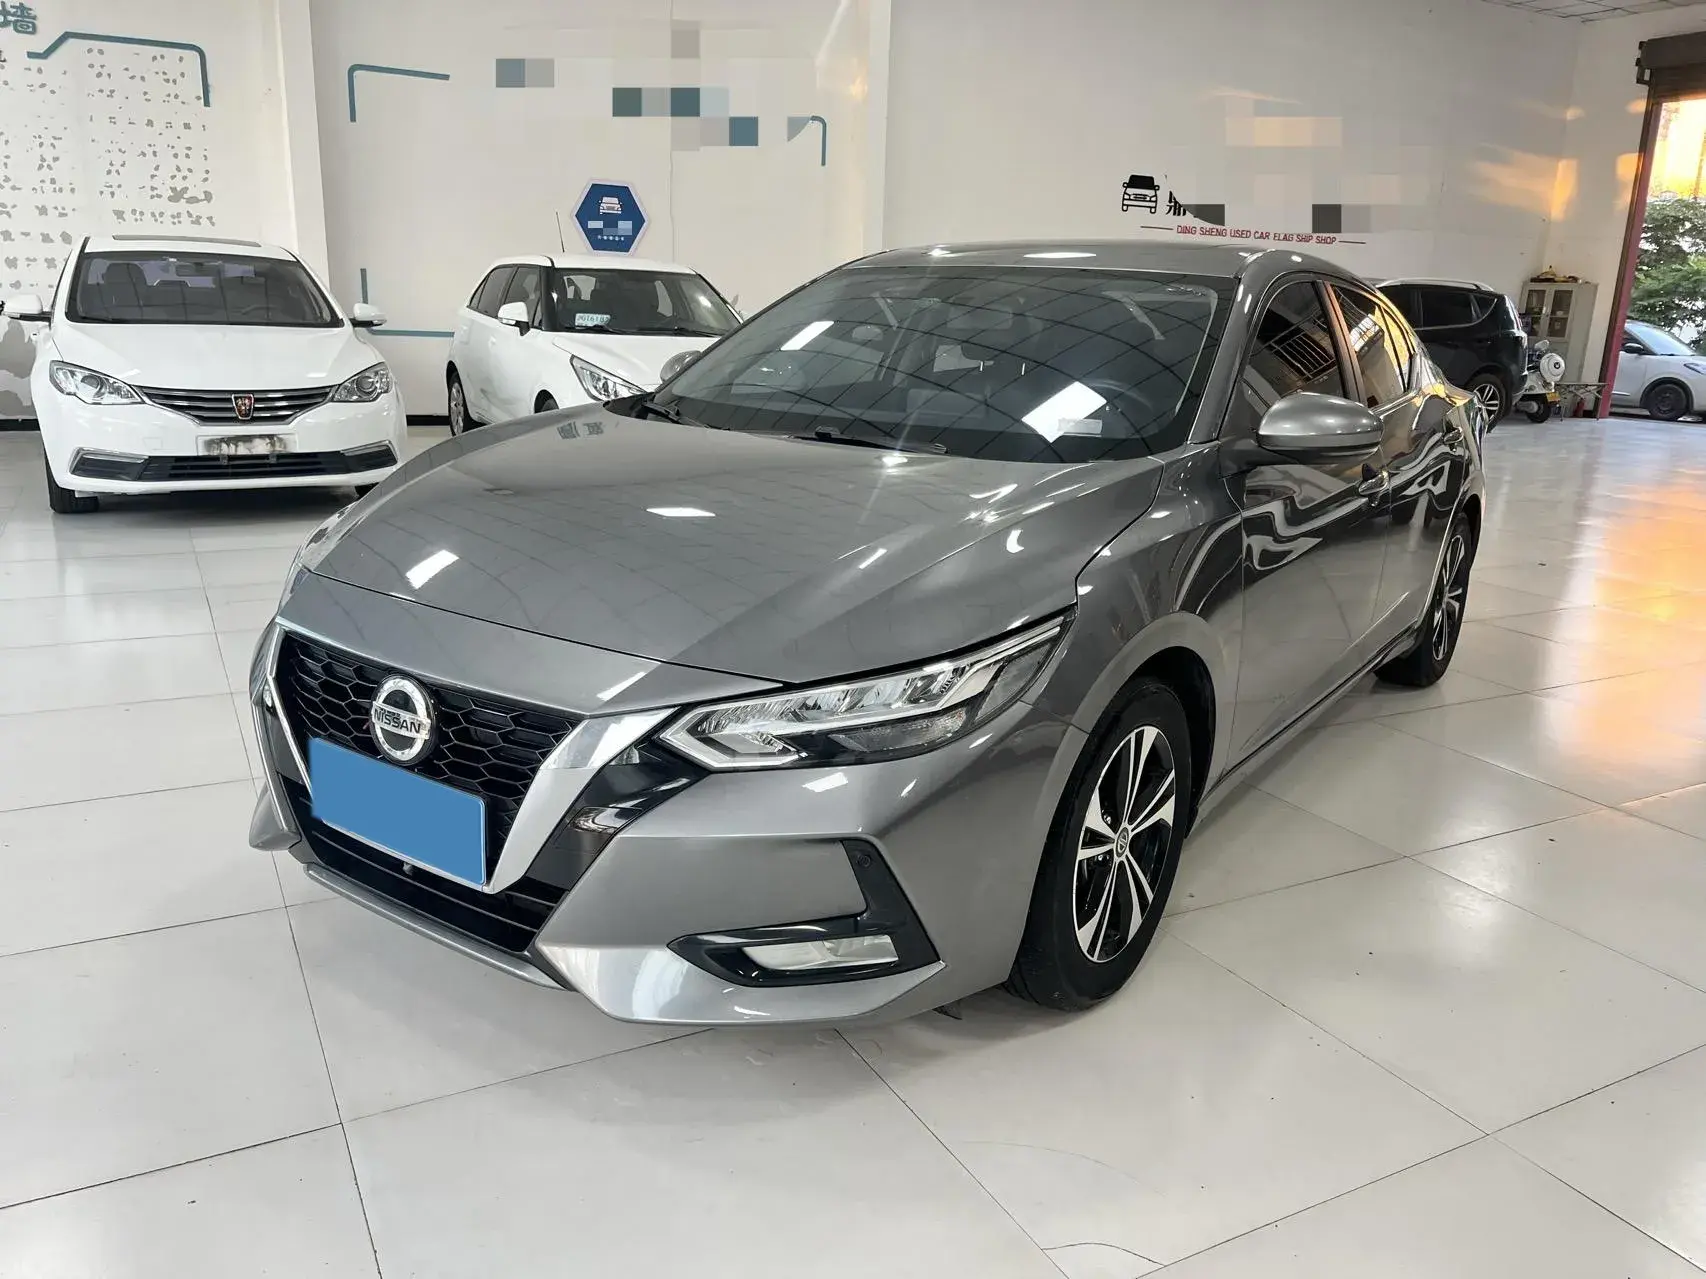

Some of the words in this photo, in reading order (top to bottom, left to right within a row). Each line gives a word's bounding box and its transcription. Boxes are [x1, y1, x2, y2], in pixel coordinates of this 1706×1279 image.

[1176, 225, 1197, 235] DING
[1199, 226, 1228, 237] SHENG
[1229, 228, 1252, 239] USED
[1253, 230, 1271, 240] CAR
[1295, 233, 1314, 243] SHIP
[1315, 235, 1337, 245] SHOP
[374, 706, 421, 735] NISSAN
